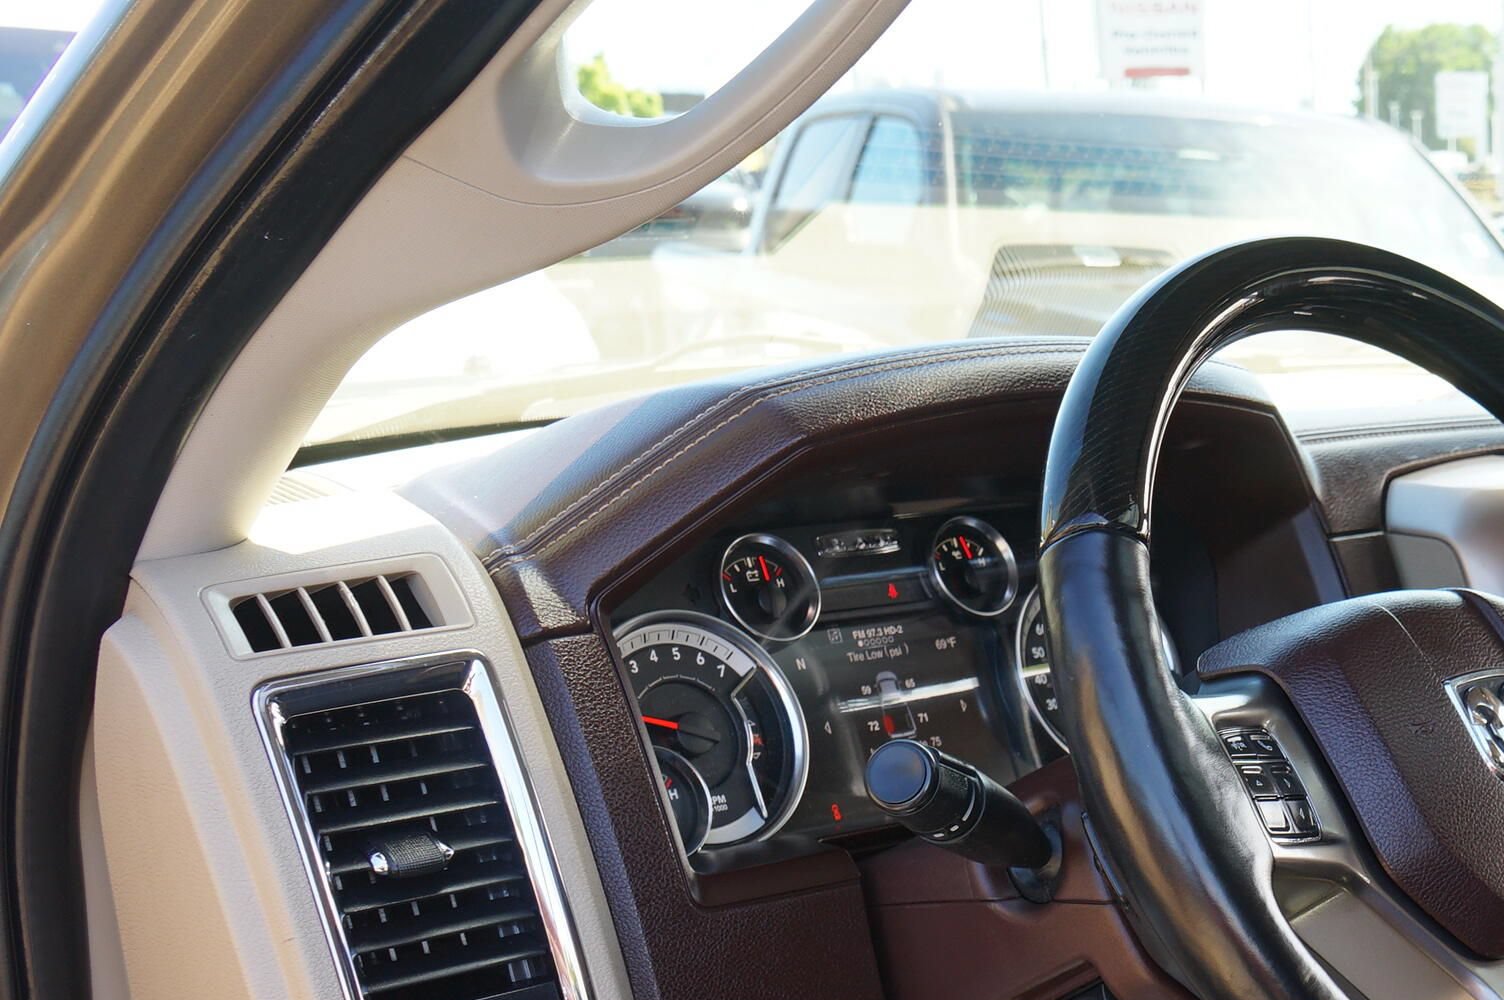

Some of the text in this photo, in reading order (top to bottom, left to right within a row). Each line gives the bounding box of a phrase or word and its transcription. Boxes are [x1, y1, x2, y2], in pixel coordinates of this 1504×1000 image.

[729, 583, 737, 593] L
[775, 578, 785, 588] H
[650, 649, 659, 663] 4
[672, 647, 681, 661] 5
[696, 651, 706, 665] 6
[847, 651, 865, 663] Tire
[865, 649, 884, 660] Low
[1031, 647, 1045, 659] 50
[630, 660, 639, 674] 3
[795, 657, 807, 671] N
[716, 664, 726, 678] 7
[1034, 673, 1048, 685] 40
[917, 712, 929, 723] 71
[867, 721, 880, 732] 72
[930, 736, 942, 748] 75
